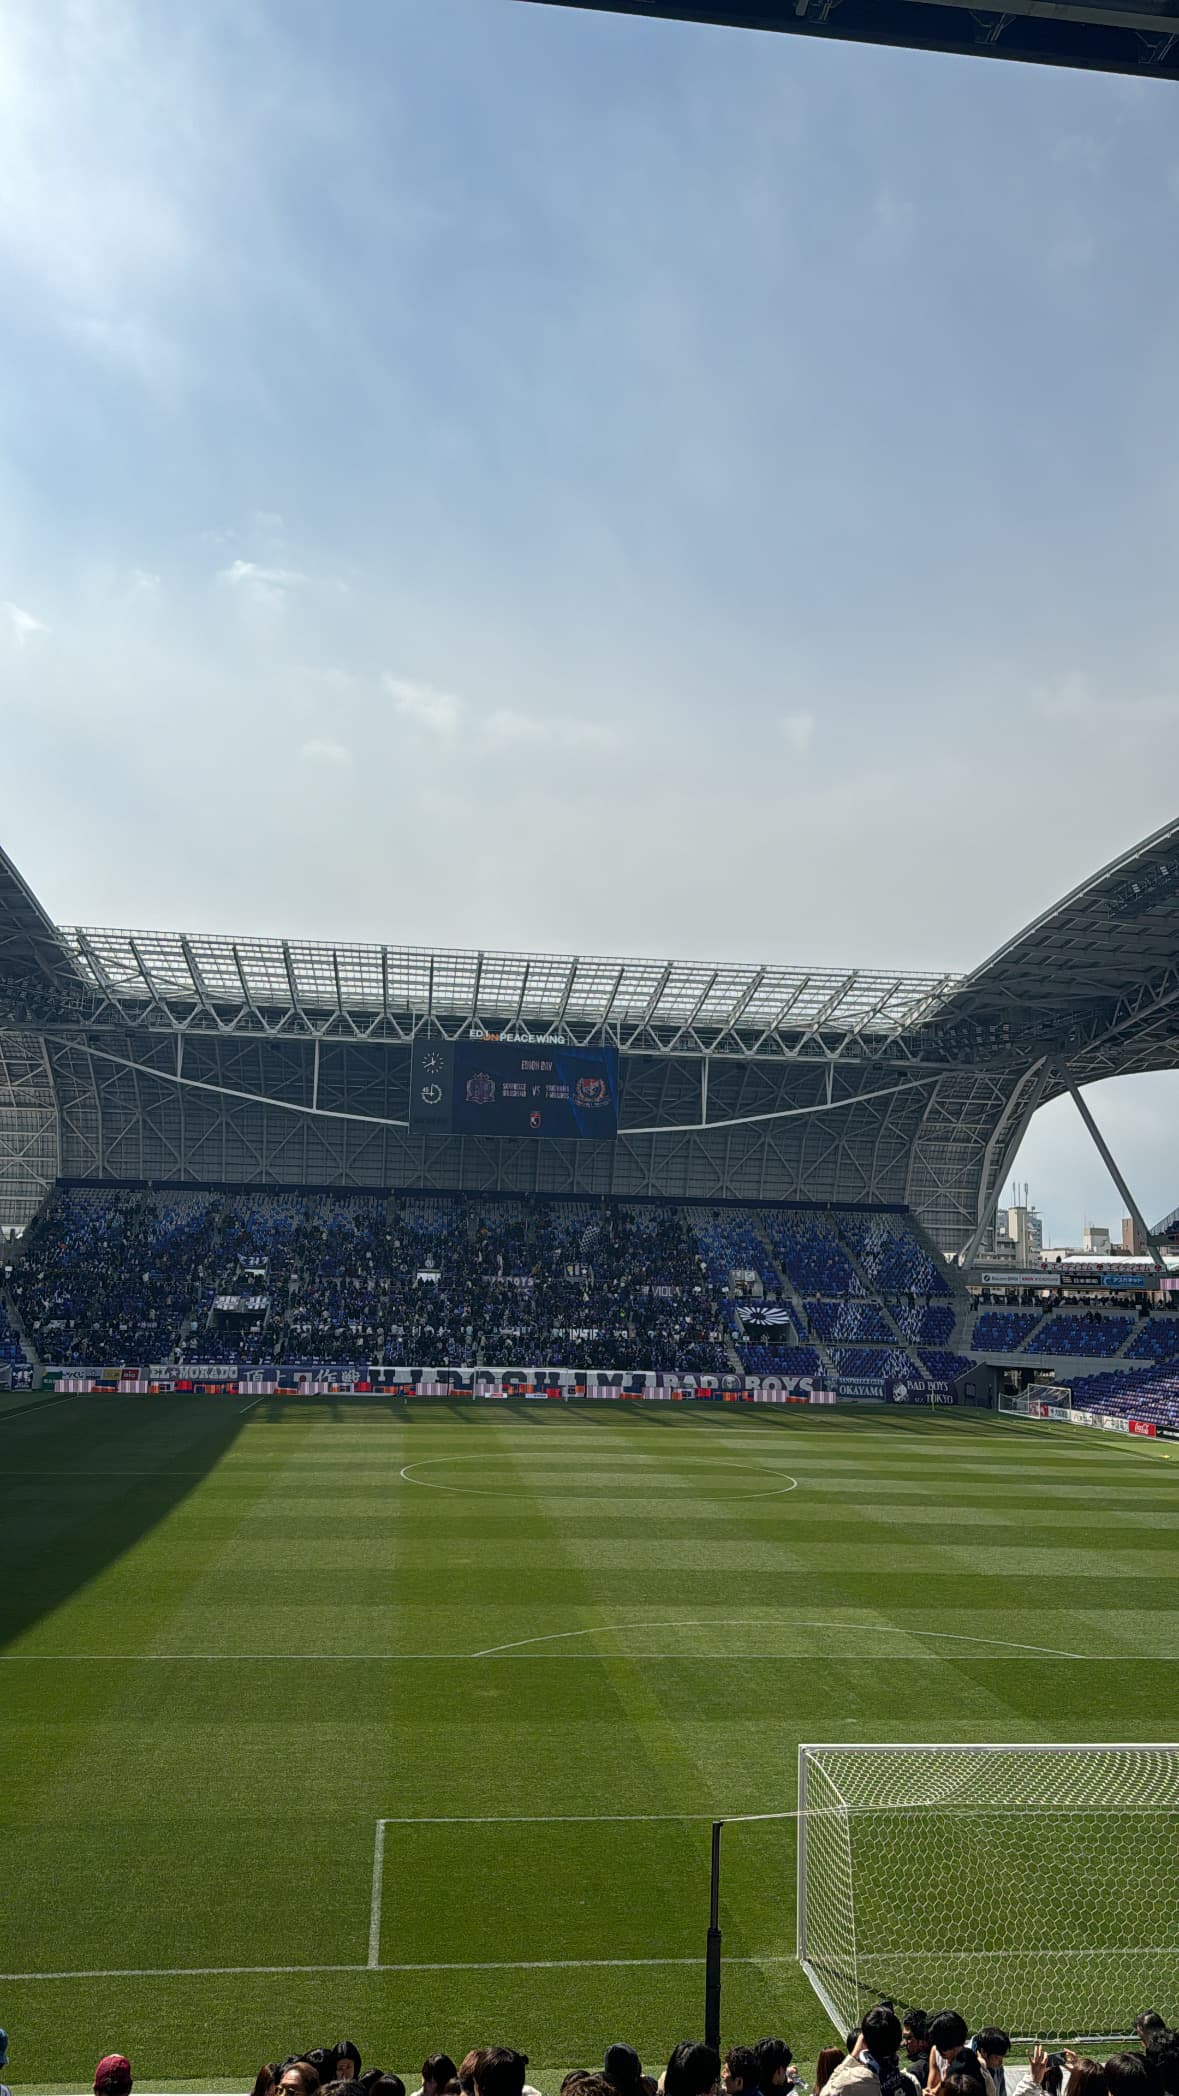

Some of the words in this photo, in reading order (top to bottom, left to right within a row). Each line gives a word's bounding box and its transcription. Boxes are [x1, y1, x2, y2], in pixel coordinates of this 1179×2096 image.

[150, 1366, 170, 1379] EL
[179, 1366, 238, 1379] MORADO
[745, 1376, 814, 1391] BOYS
[906, 1380, 926, 1391] BAD
[927, 1381, 949, 1392] BOYS
[839, 1384, 884, 1396] OKAYAMA
[926, 1393, 954, 1404] TOKYO
